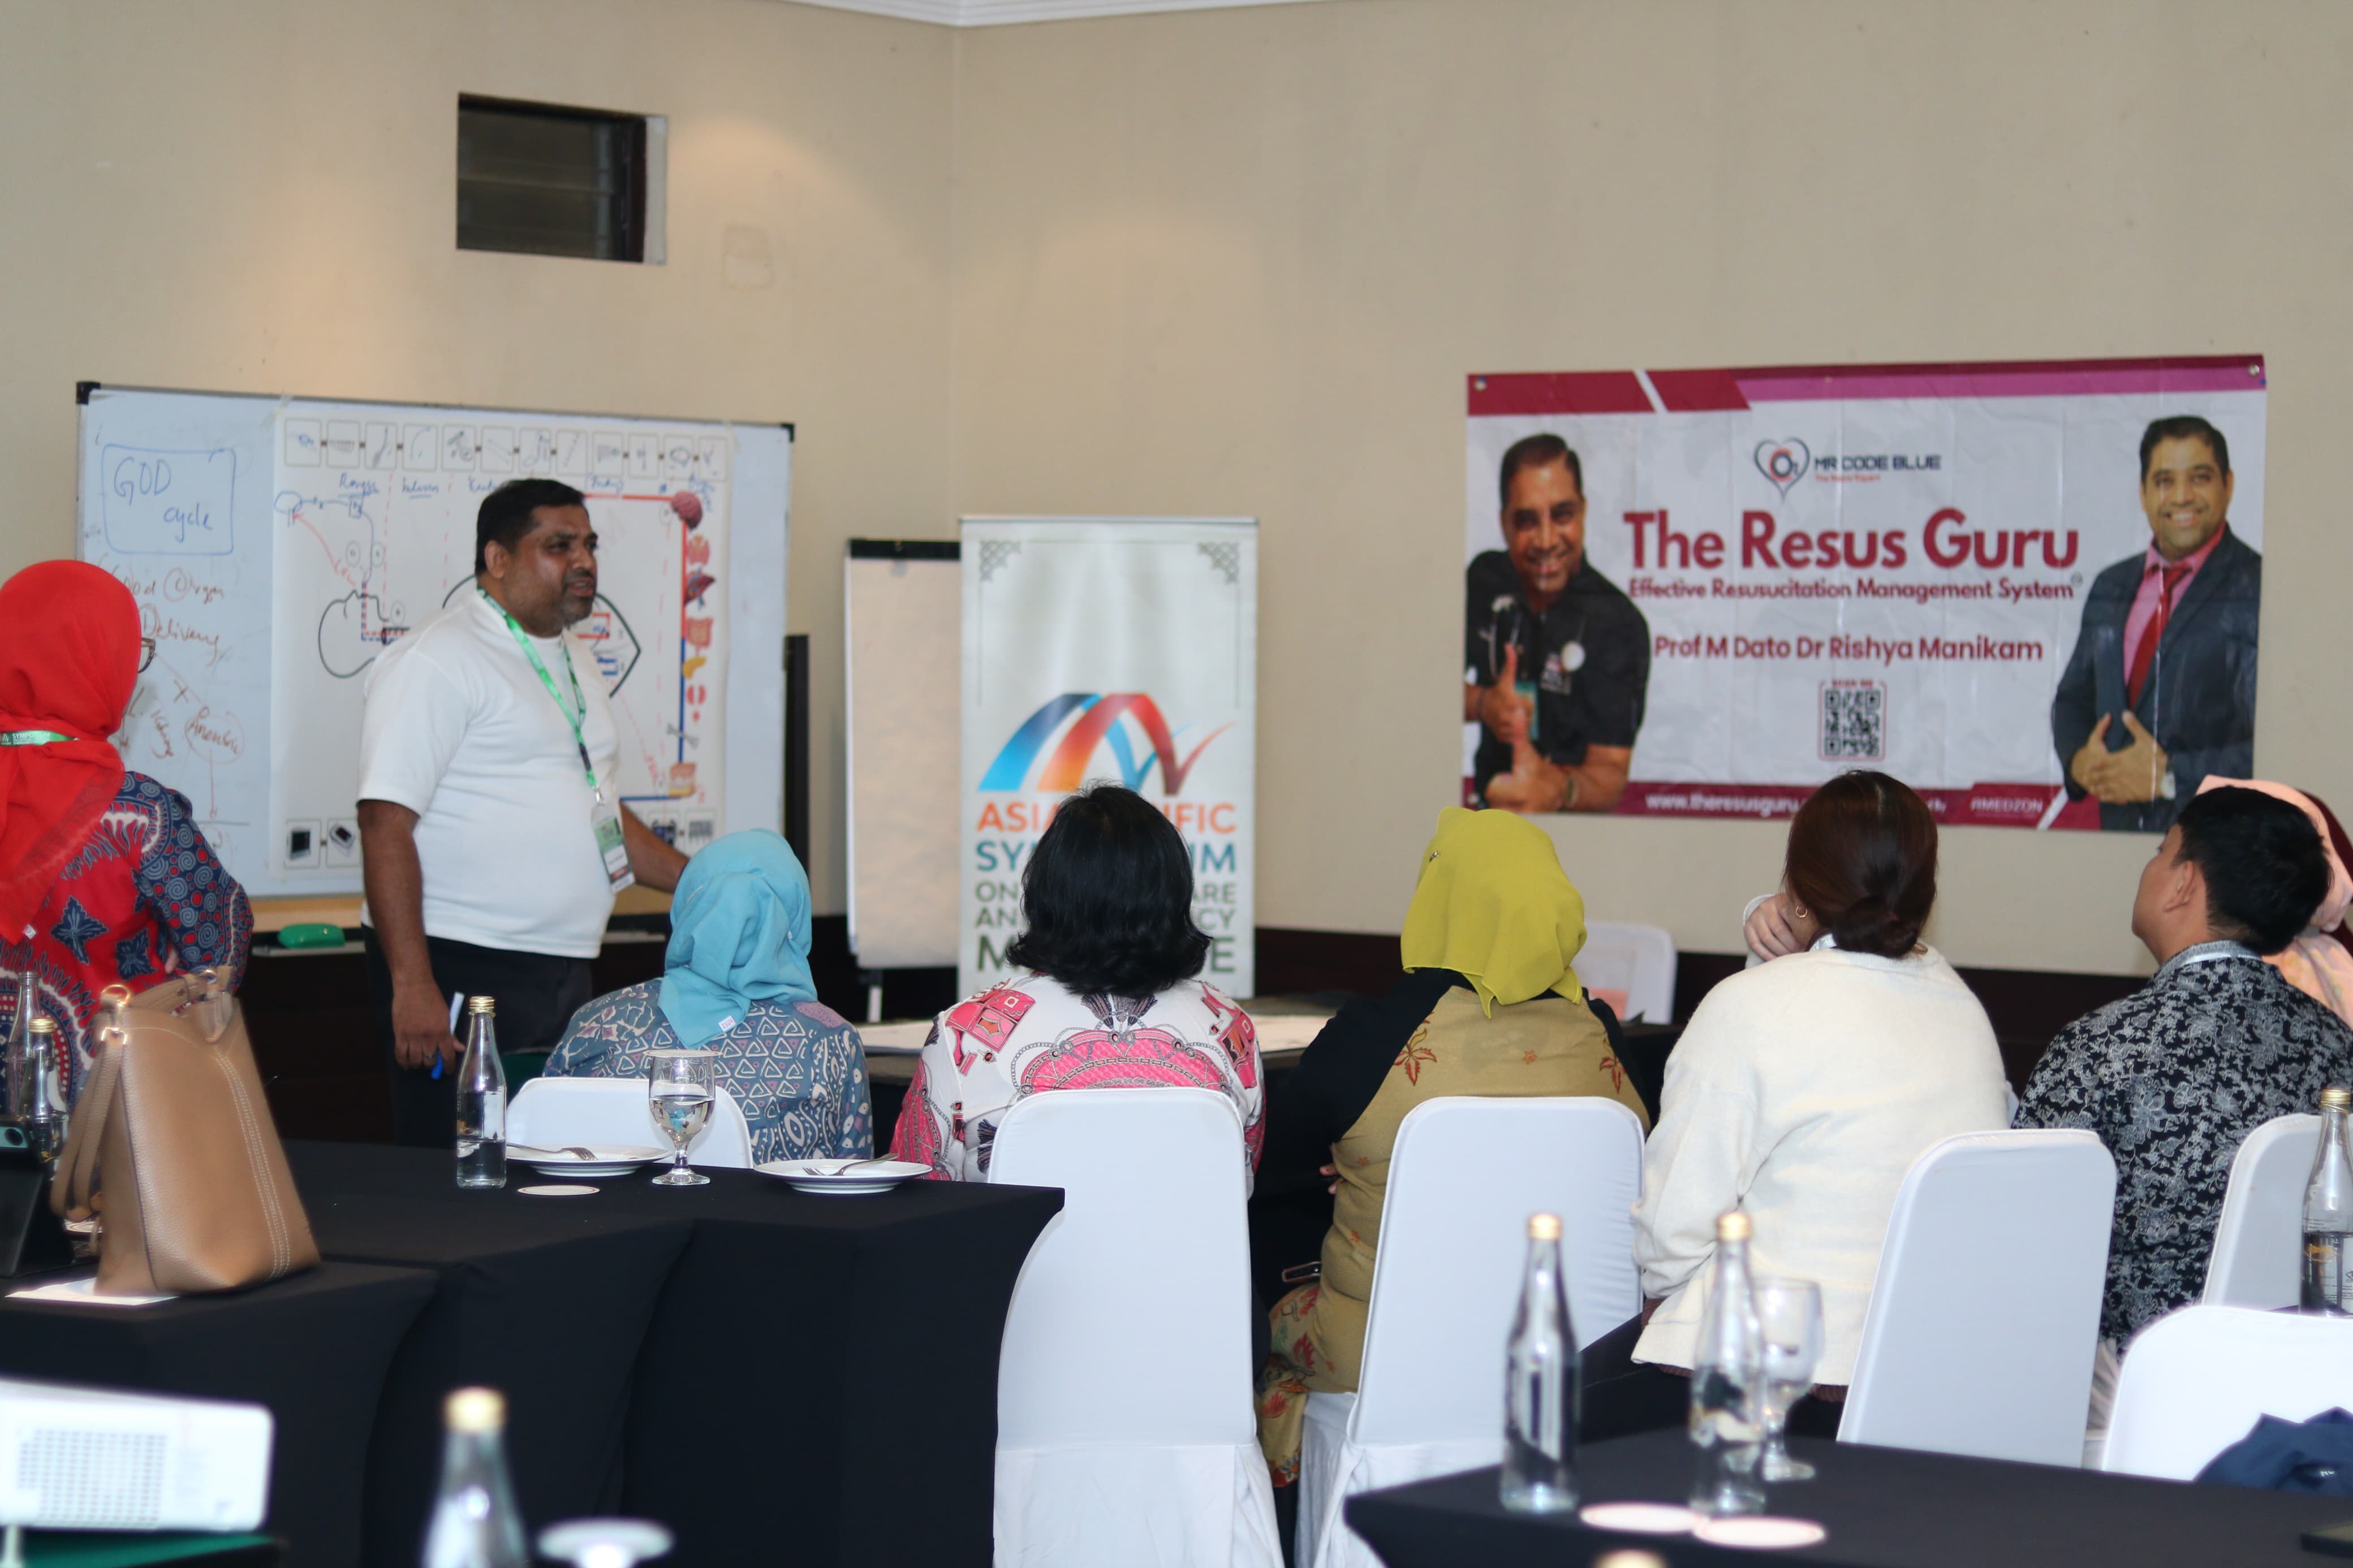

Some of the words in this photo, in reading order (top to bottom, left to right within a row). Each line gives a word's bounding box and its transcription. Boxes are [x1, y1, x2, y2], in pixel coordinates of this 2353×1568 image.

[1814, 456, 1838, 471] MR
[1842, 456, 1889, 472] CODE
[1893, 455, 1942, 471] BLUE
[1623, 509, 1725, 569] The
[1742, 510, 1907, 569] Resus
[1923, 507, 2079, 569] Guru
[1629, 577, 1706, 599] Effective
[1711, 577, 1852, 599] Resusucitation
[1857, 577, 1993, 605] Management
[1999, 577, 2075, 604] System
[1653, 635, 1702, 658] Prof
[1706, 637, 1729, 658] M
[1734, 637, 1792, 659] Dato
[1796, 636, 1825, 659] Dr
[1829, 634, 1914, 667] Rishya
[1919, 634, 2044, 661] Manikam
[975, 906, 1028, 928] AN
